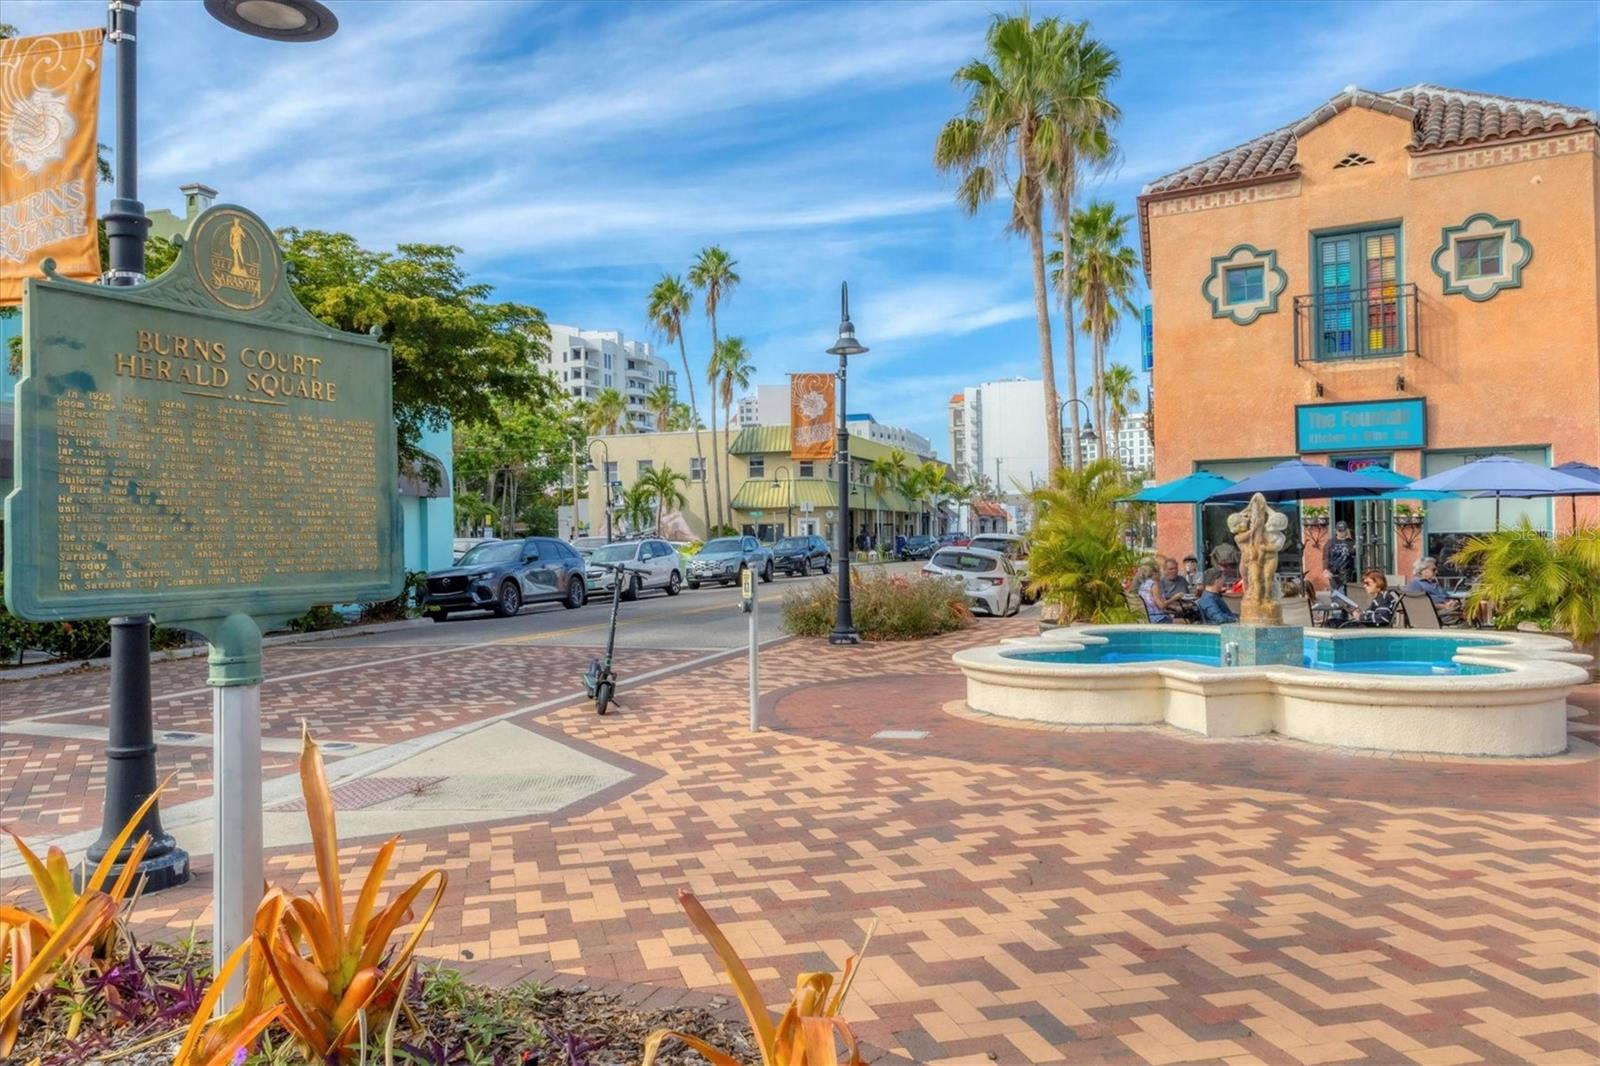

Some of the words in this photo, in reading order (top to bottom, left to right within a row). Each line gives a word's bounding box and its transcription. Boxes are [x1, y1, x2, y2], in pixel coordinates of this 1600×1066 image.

[115, 352, 230, 388] HERALD
[246, 372, 337, 402] SQUARE
[137, 330, 226, 363] BURNS
[240, 347, 322, 377] COURT
[1308, 413, 1335, 428] The
